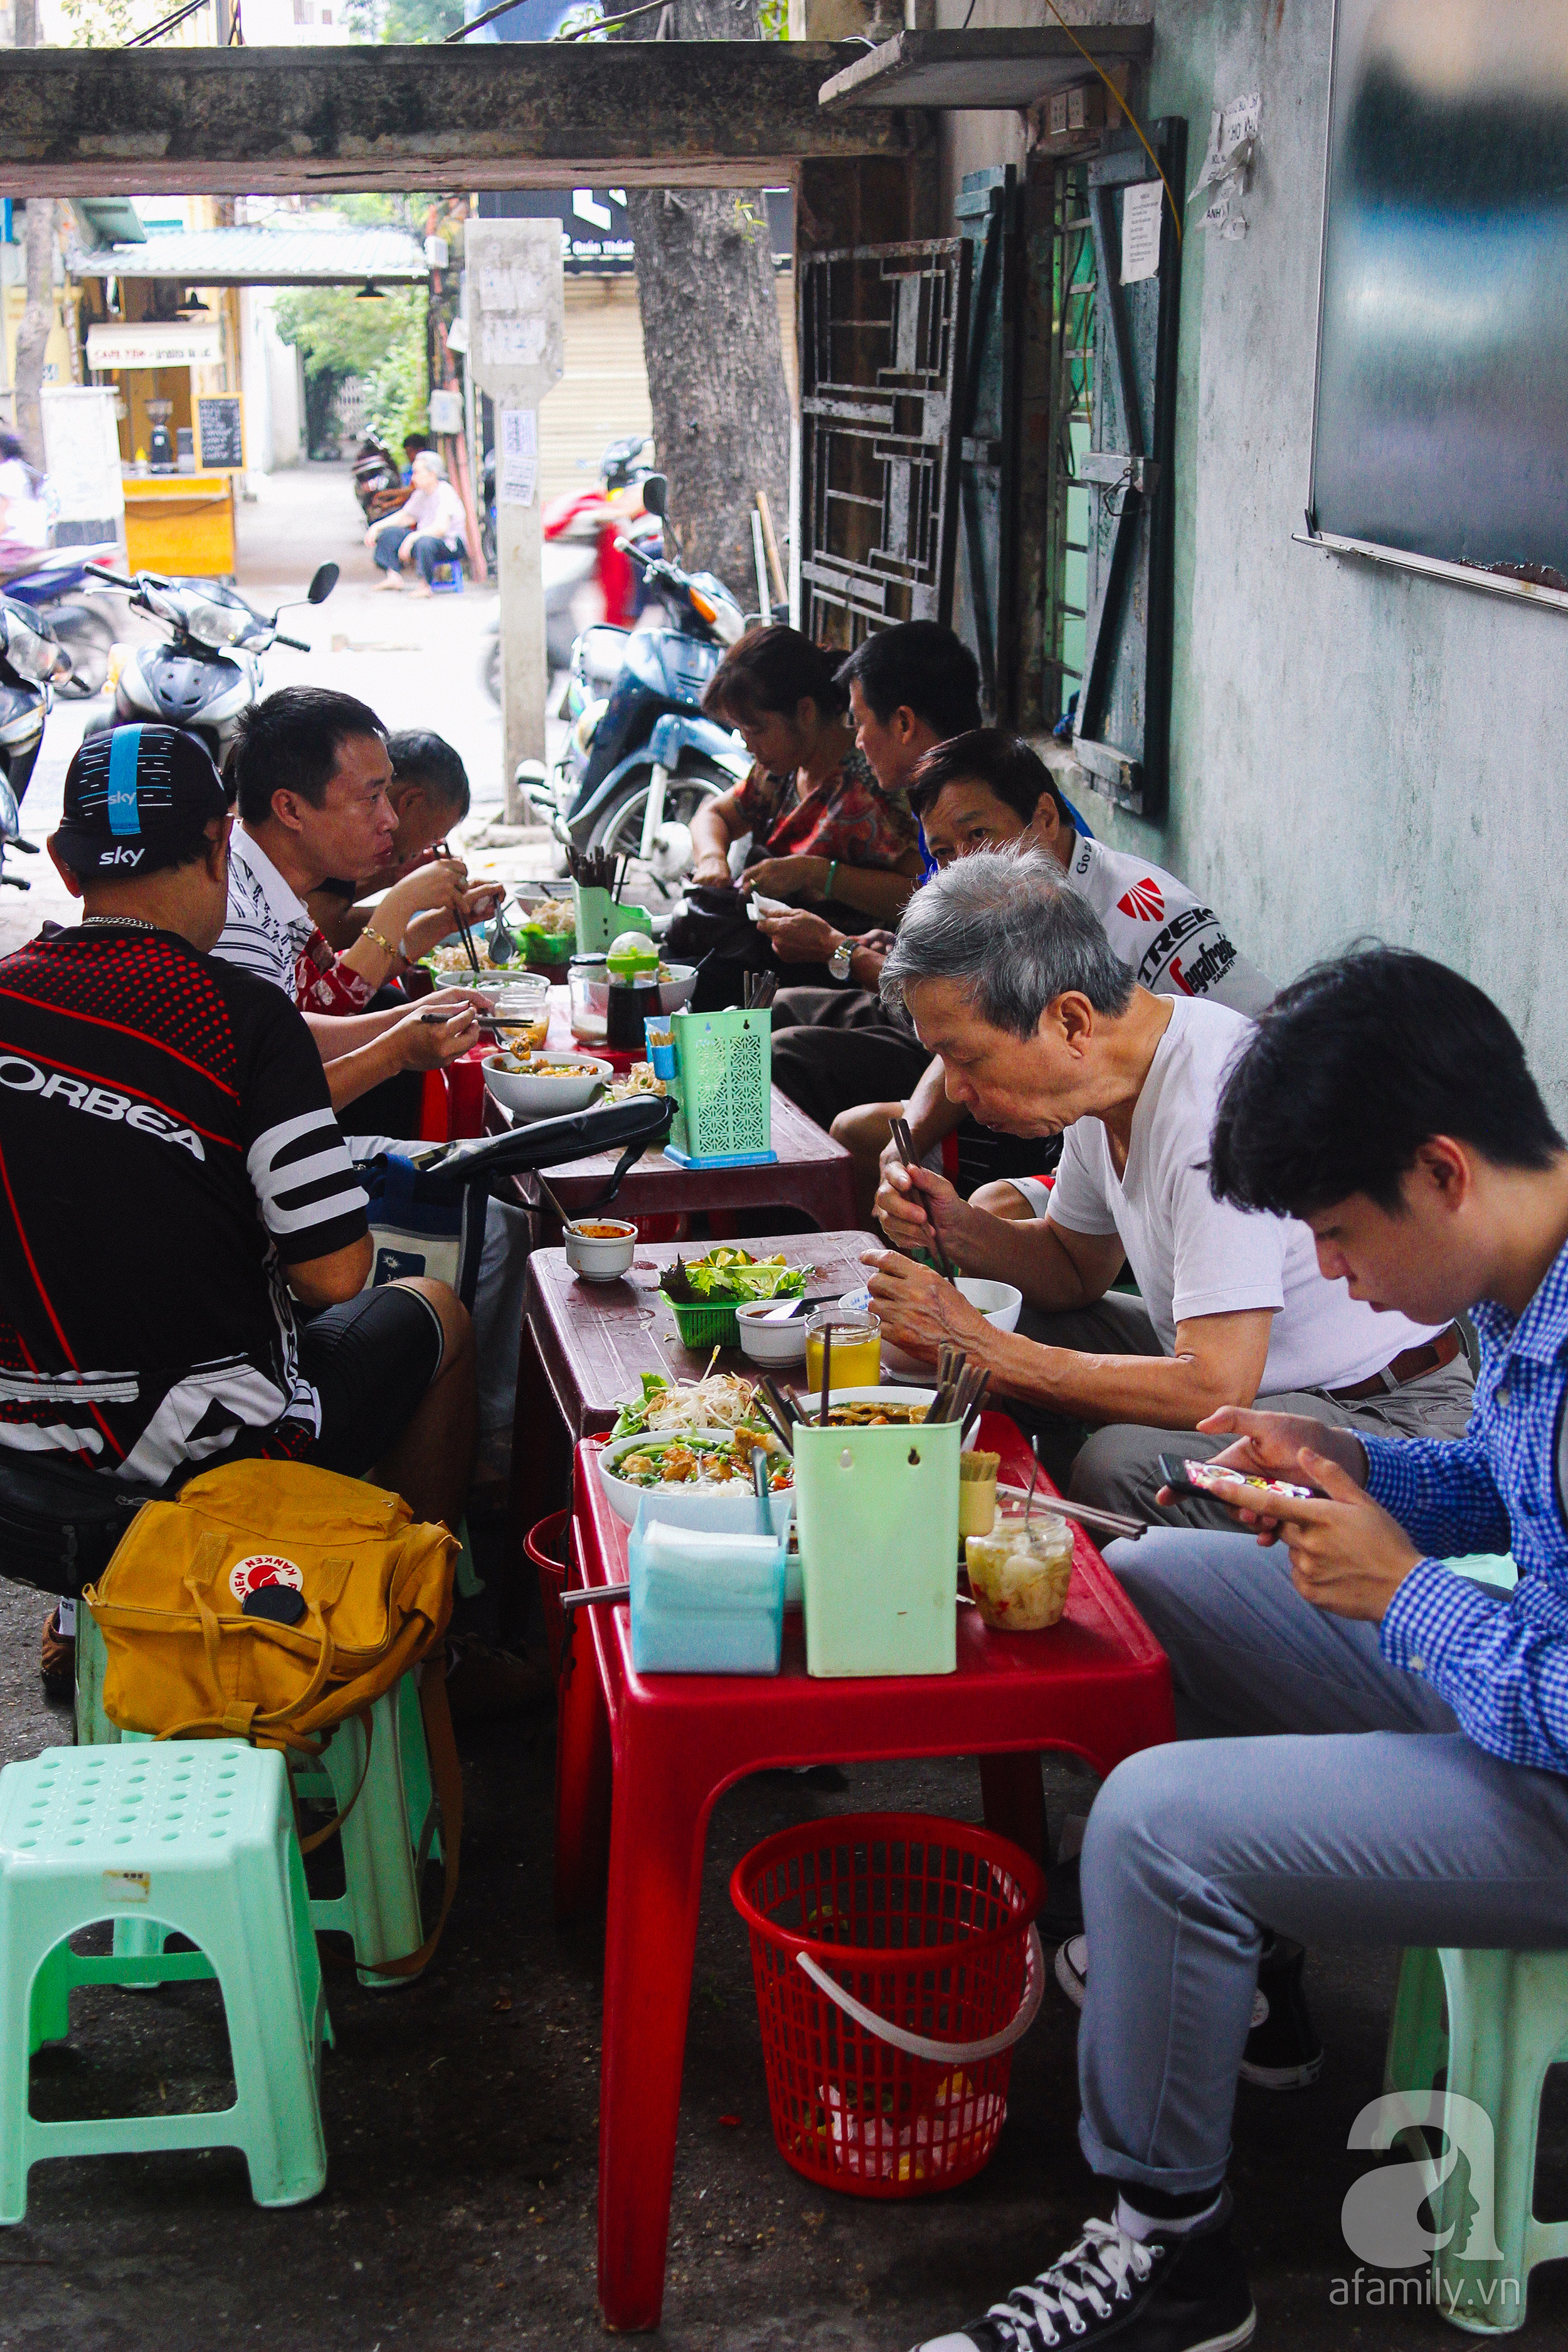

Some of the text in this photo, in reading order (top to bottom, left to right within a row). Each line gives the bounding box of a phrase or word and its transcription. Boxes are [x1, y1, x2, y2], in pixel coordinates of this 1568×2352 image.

[108, 790, 137, 806] sky
[99, 846, 145, 867] sky
[1076, 854, 1091, 874] Go
[1137, 908, 1214, 983] TREK
[1211, 960, 1236, 984] ZANETTI
[0, 1056, 205, 1161] ORBEA
